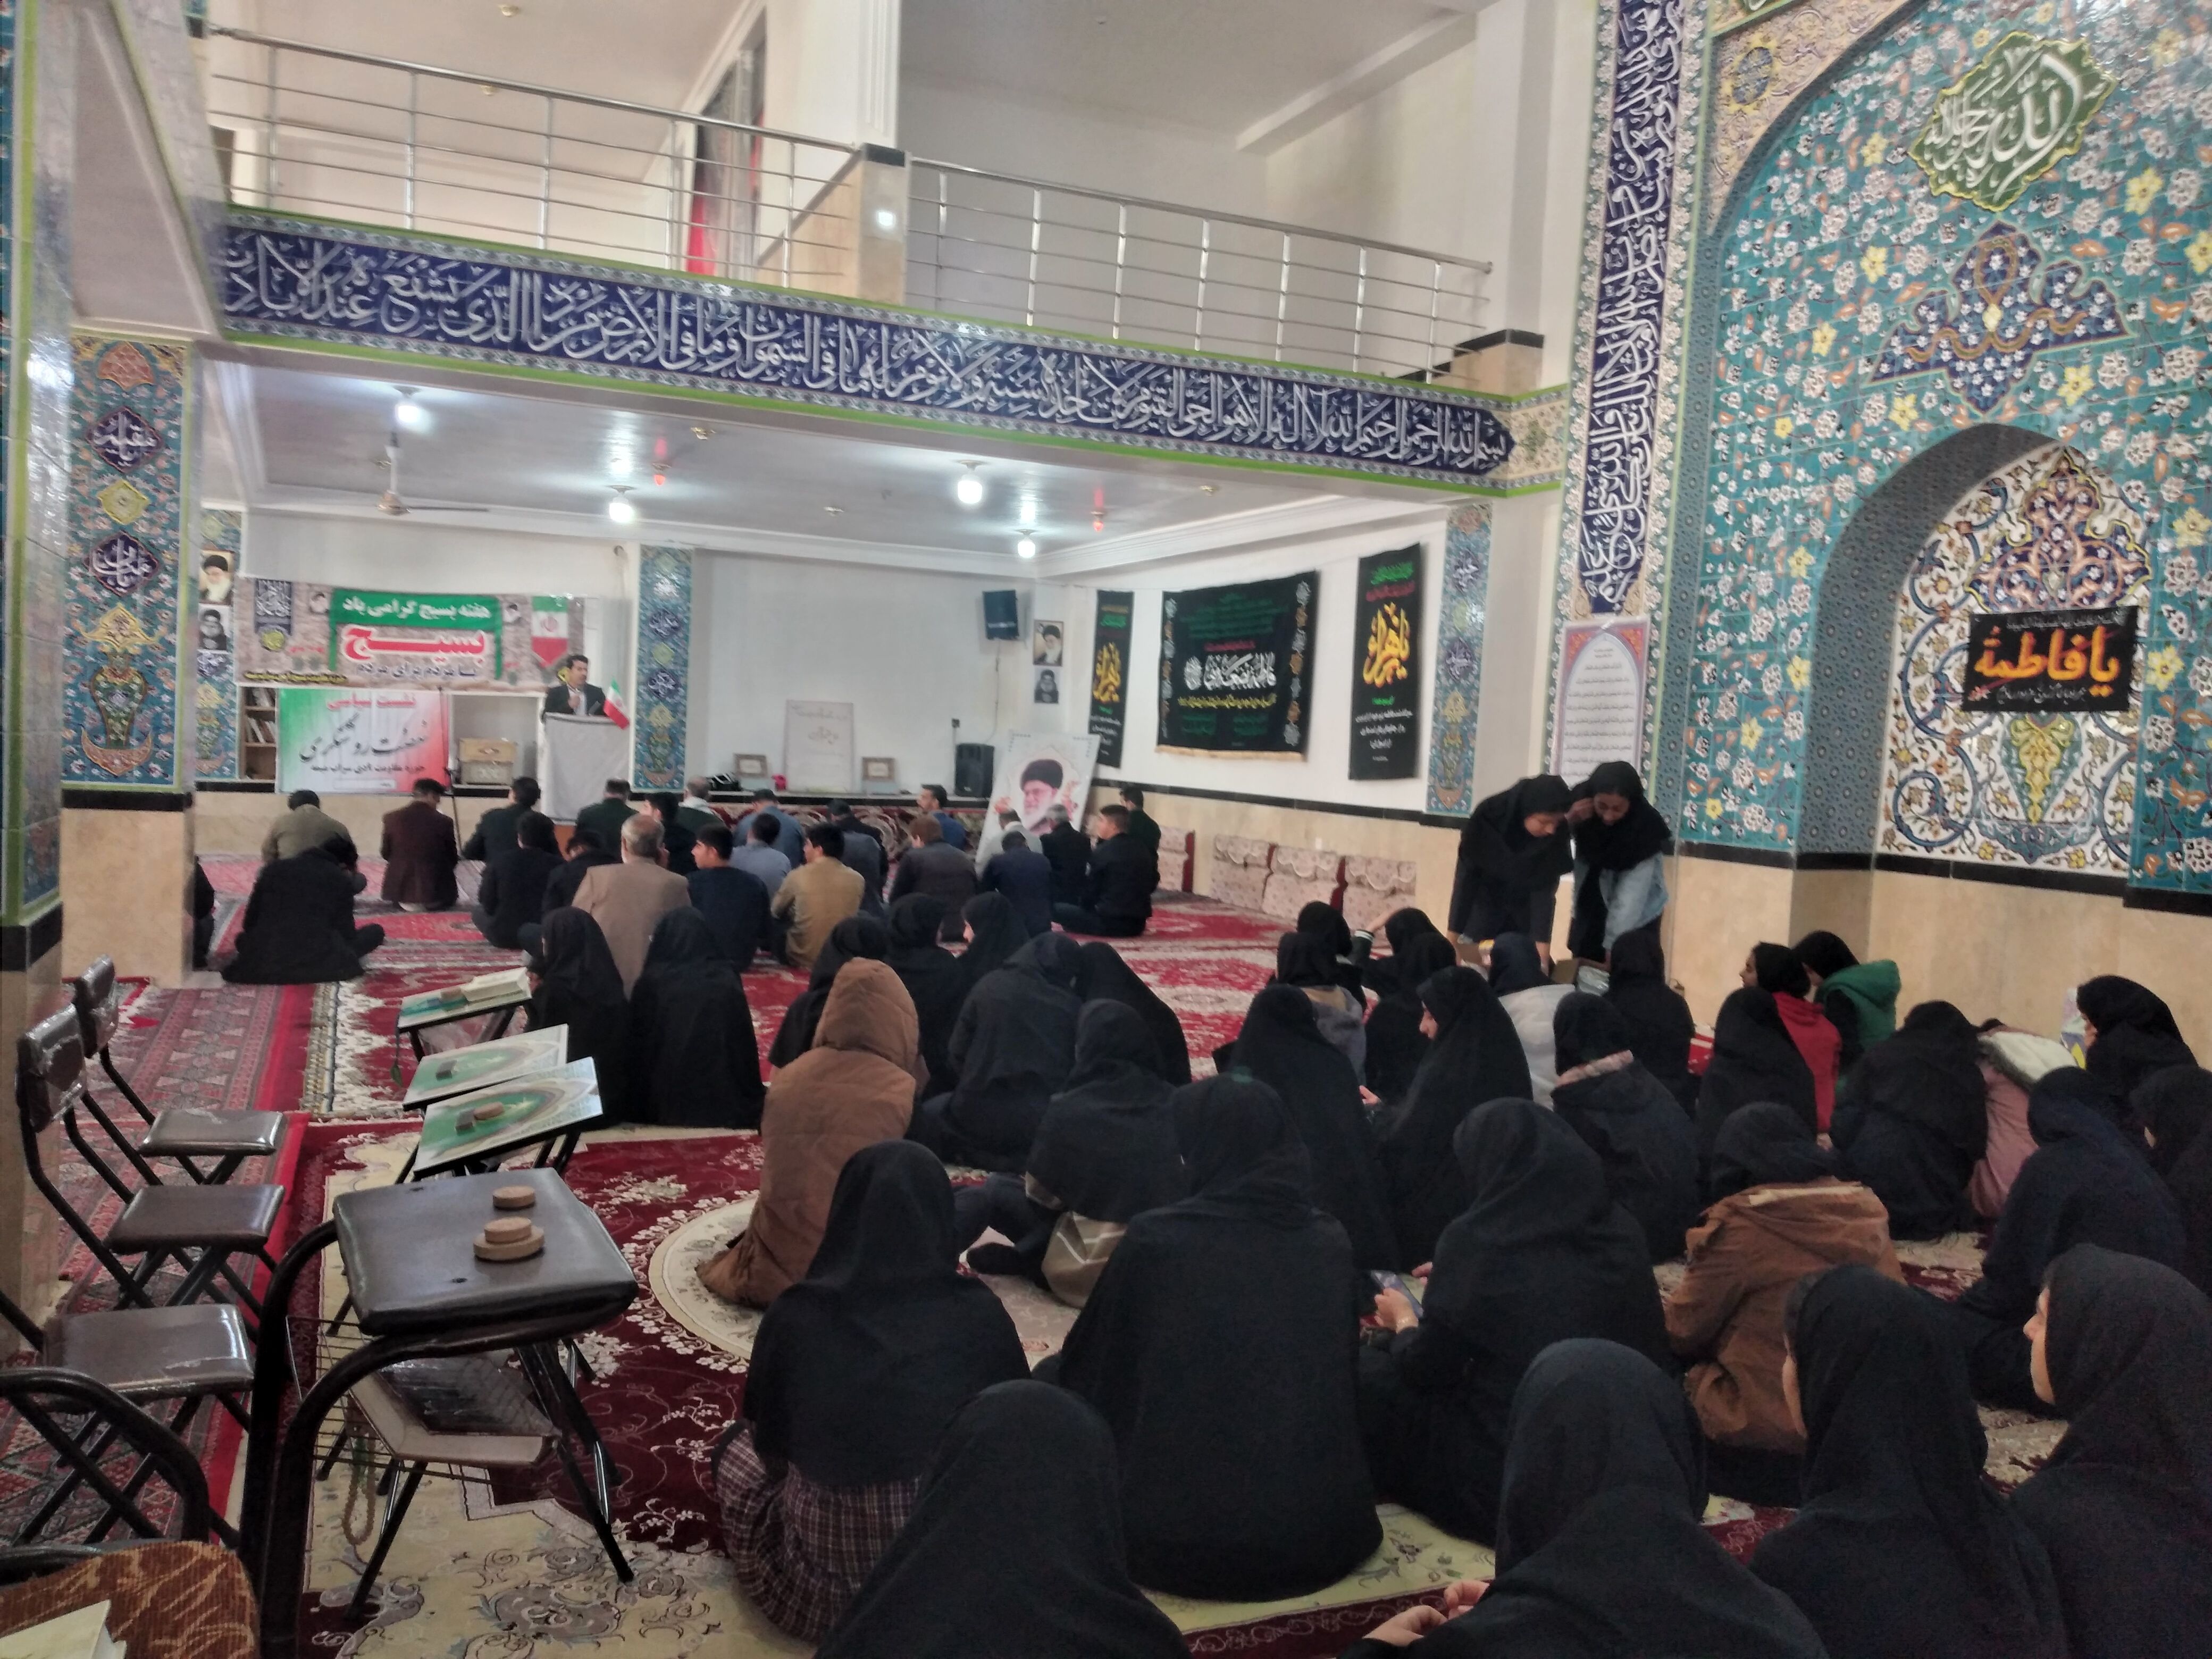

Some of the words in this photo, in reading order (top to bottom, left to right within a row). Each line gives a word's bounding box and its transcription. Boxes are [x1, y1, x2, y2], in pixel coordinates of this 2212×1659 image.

[342, 596, 366, 616] باد
[367, 598, 418, 619] گرامی
[418, 604, 457, 621] بسیج
[458, 602, 491, 618] هفته
[345, 627, 485, 664] بسیج
